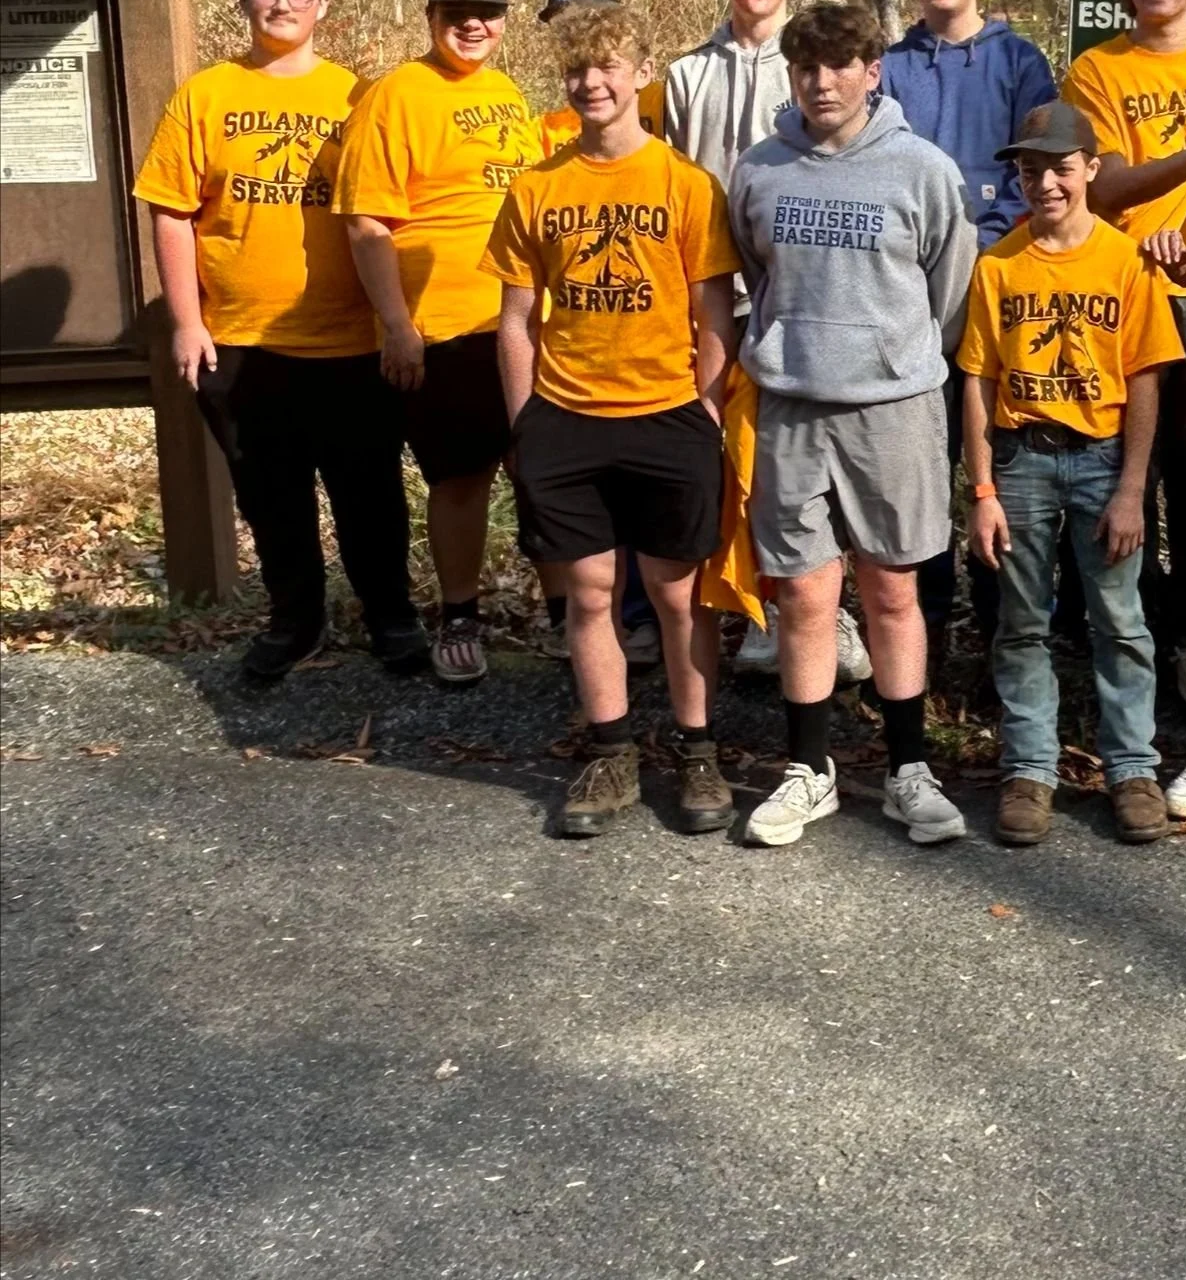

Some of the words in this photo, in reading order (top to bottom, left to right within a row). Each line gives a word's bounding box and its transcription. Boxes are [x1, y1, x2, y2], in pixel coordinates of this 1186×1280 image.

[231, 177, 331, 208] SERVES
[774, 207, 884, 233] BRUISERS
[825, 200, 885, 214] KEYSTONE
[543, 204, 669, 241] SOLANCO
[773, 226, 880, 252] BASEBALL
[557, 283, 653, 312] SERVES
[1000, 293, 1120, 330] SOLANCO
[1009, 373, 1102, 401] SERVES
